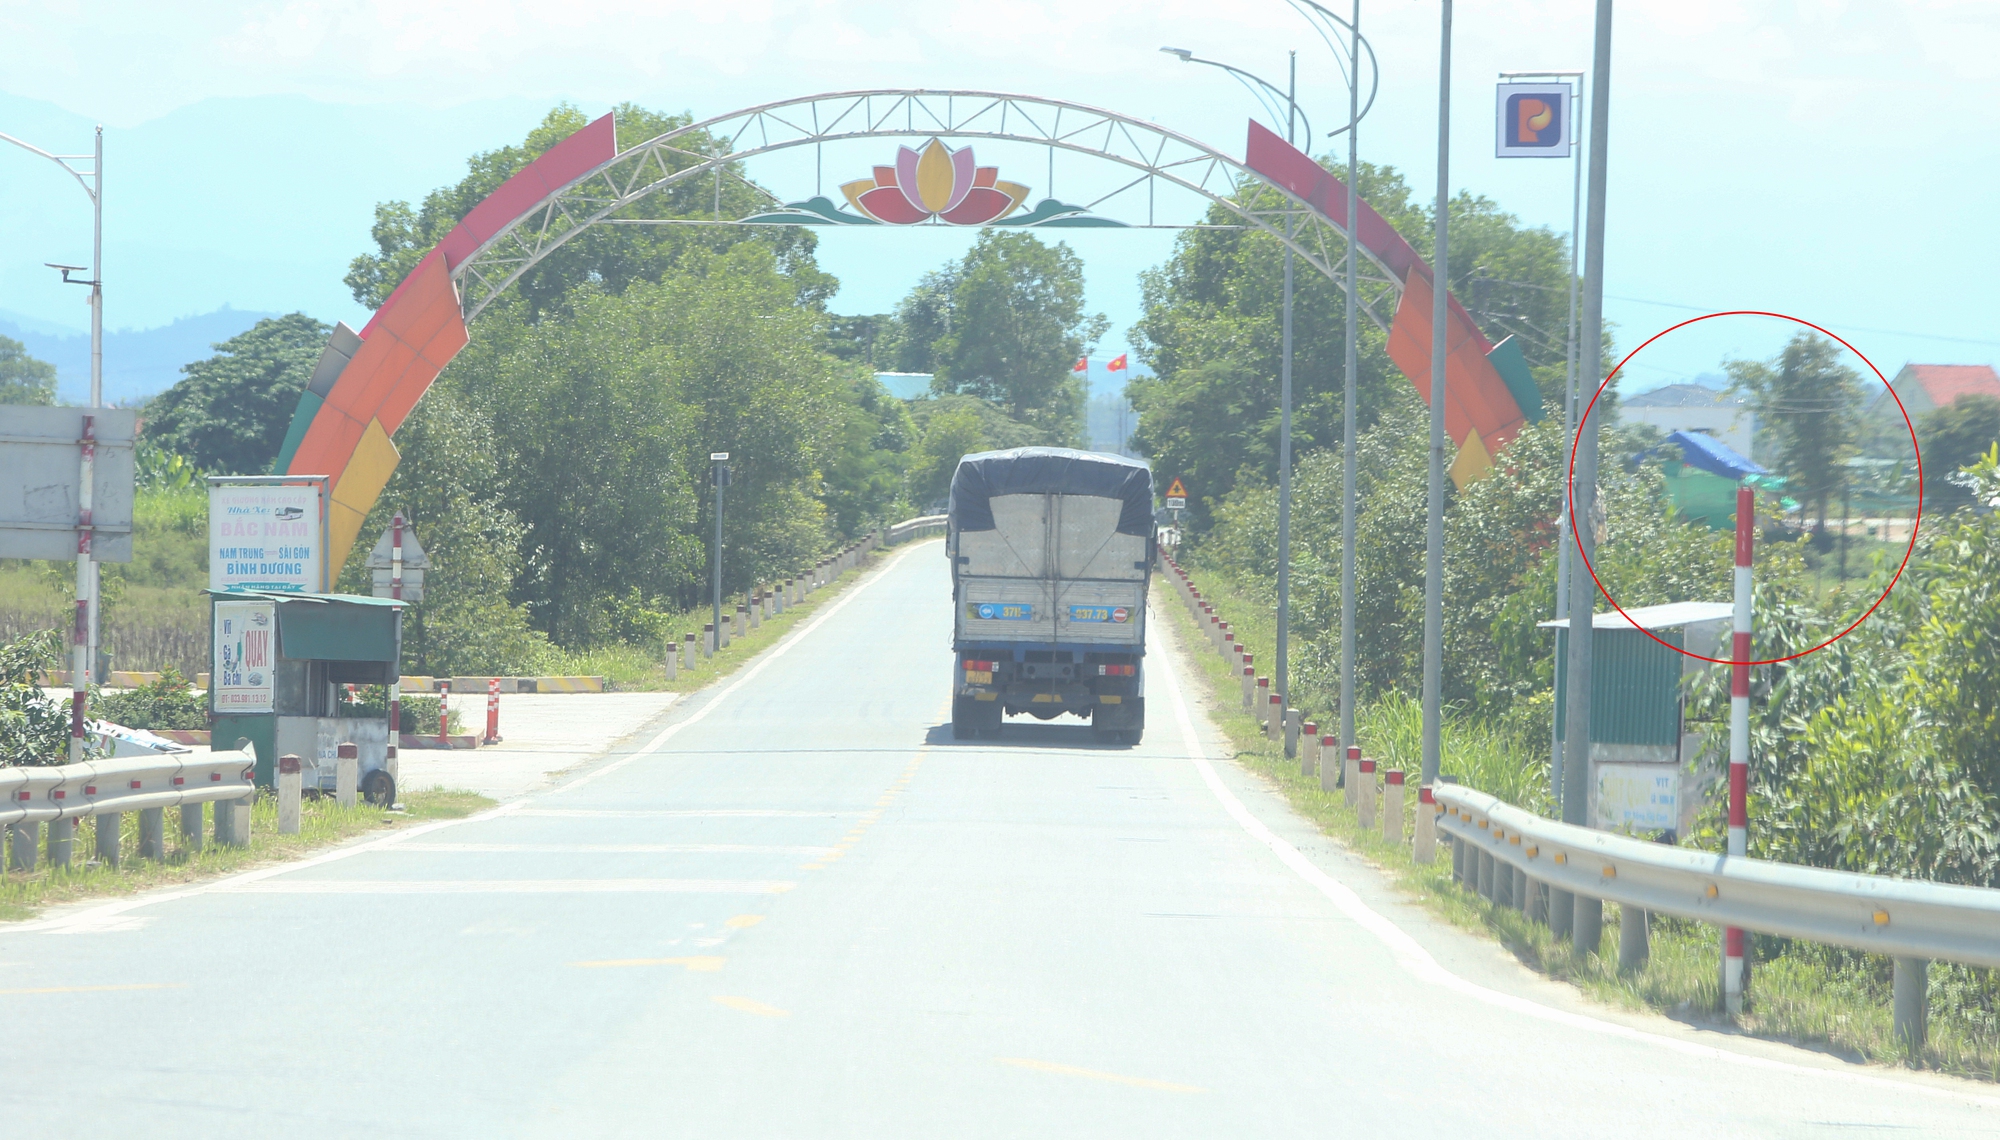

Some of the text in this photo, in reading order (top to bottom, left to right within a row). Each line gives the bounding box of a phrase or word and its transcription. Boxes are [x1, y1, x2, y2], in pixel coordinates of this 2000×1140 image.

[220, 517, 308, 537] BẮC NAM
[219, 544, 310, 560] NAM TRUNG SÀI GÒN
[227, 560, 302, 575] BÌNH DƯƠNG
[223, 619, 232, 638] Vịt
[223, 644, 232, 660] Gà
[245, 630, 269, 671] QUAY
